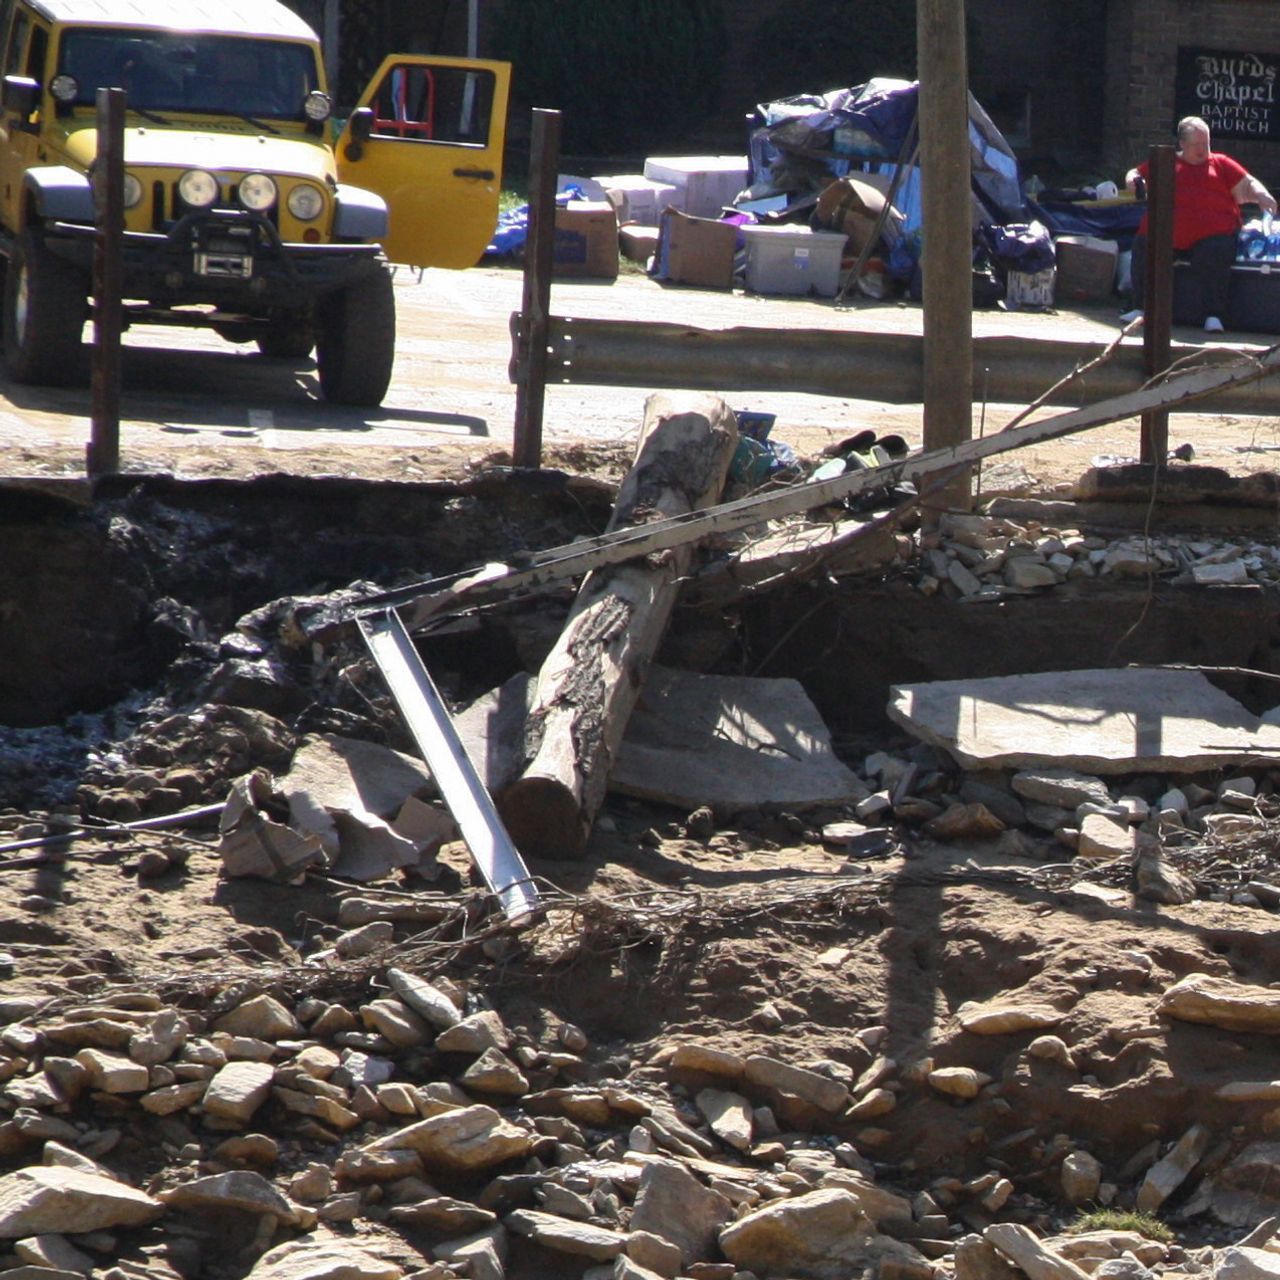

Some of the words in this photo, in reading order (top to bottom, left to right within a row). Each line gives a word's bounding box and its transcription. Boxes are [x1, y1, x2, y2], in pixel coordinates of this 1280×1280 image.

[1195, 53, 1278, 86] Byrds
[1196, 79, 1275, 106] Chapel
[1201, 104, 1271, 119] BAPTIST
